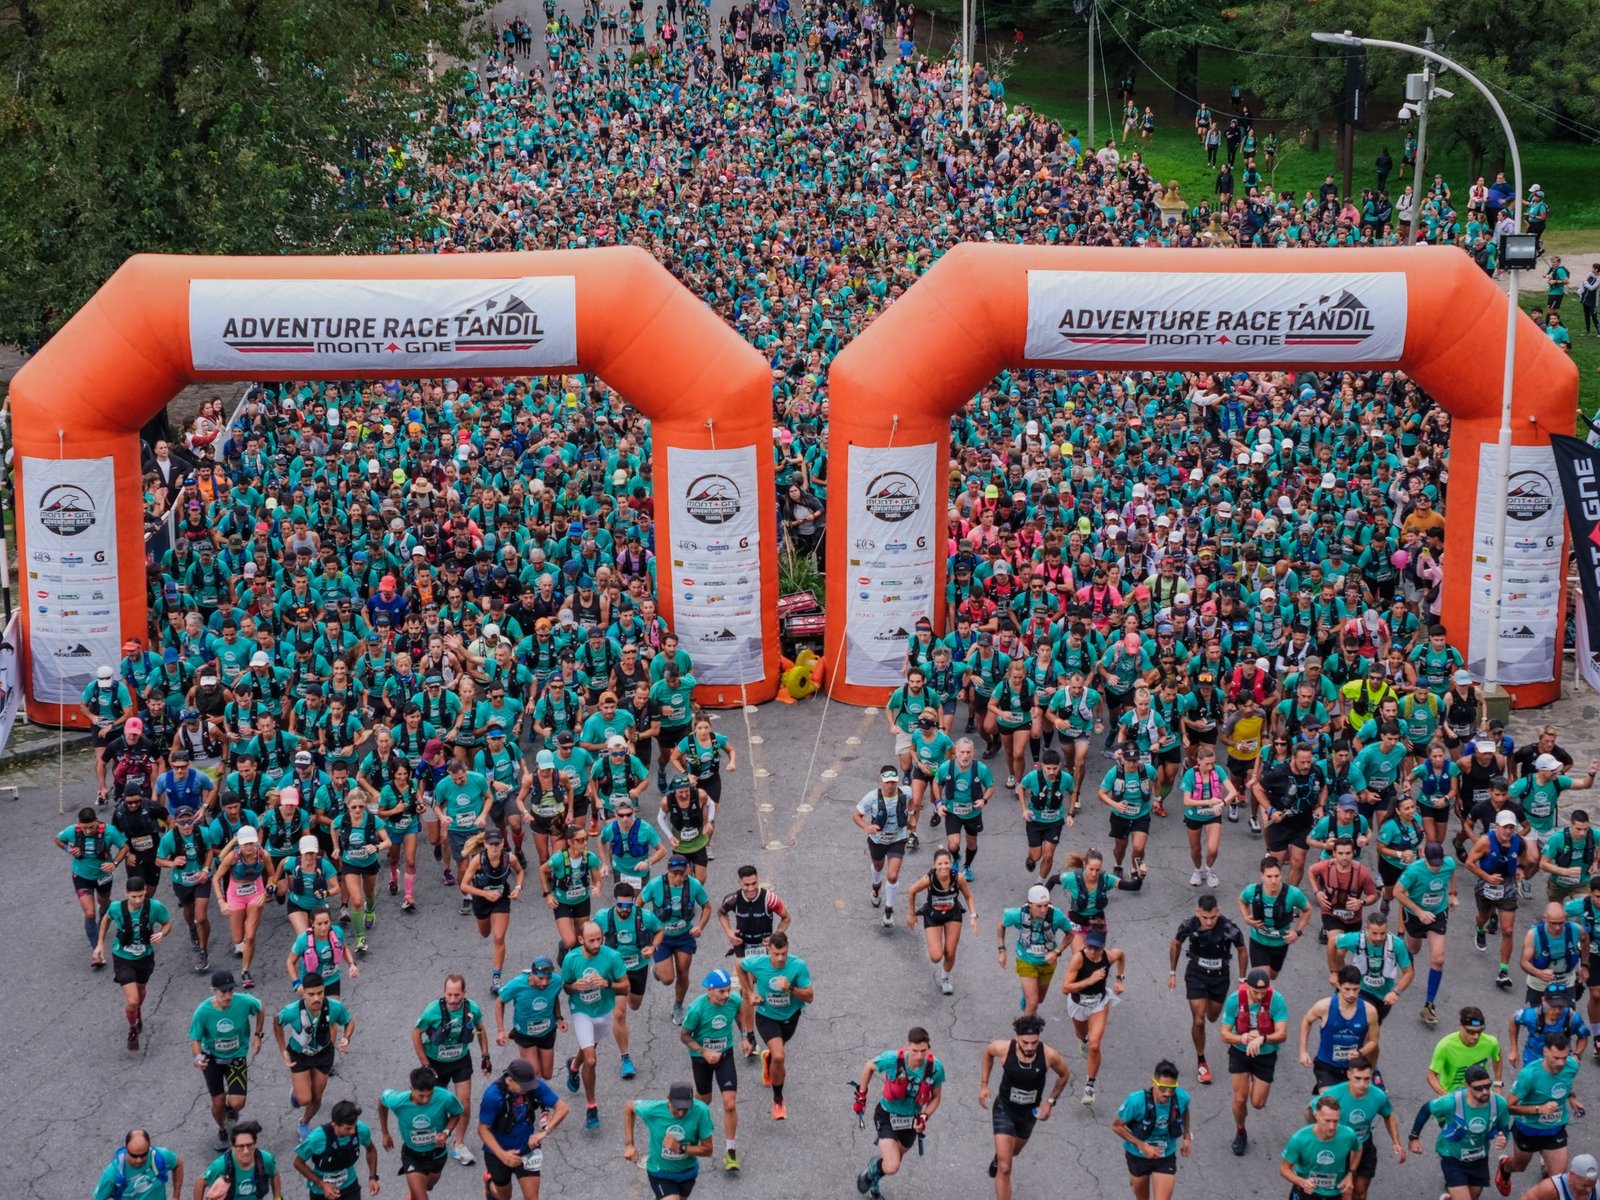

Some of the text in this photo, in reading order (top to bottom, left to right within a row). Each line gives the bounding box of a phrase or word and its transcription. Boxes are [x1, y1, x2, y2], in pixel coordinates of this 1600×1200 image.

[222, 314, 545, 339] ADVENTURE RACE TANDIL
[1058, 309, 1375, 331] ADVENTURE RACE TANDIL
